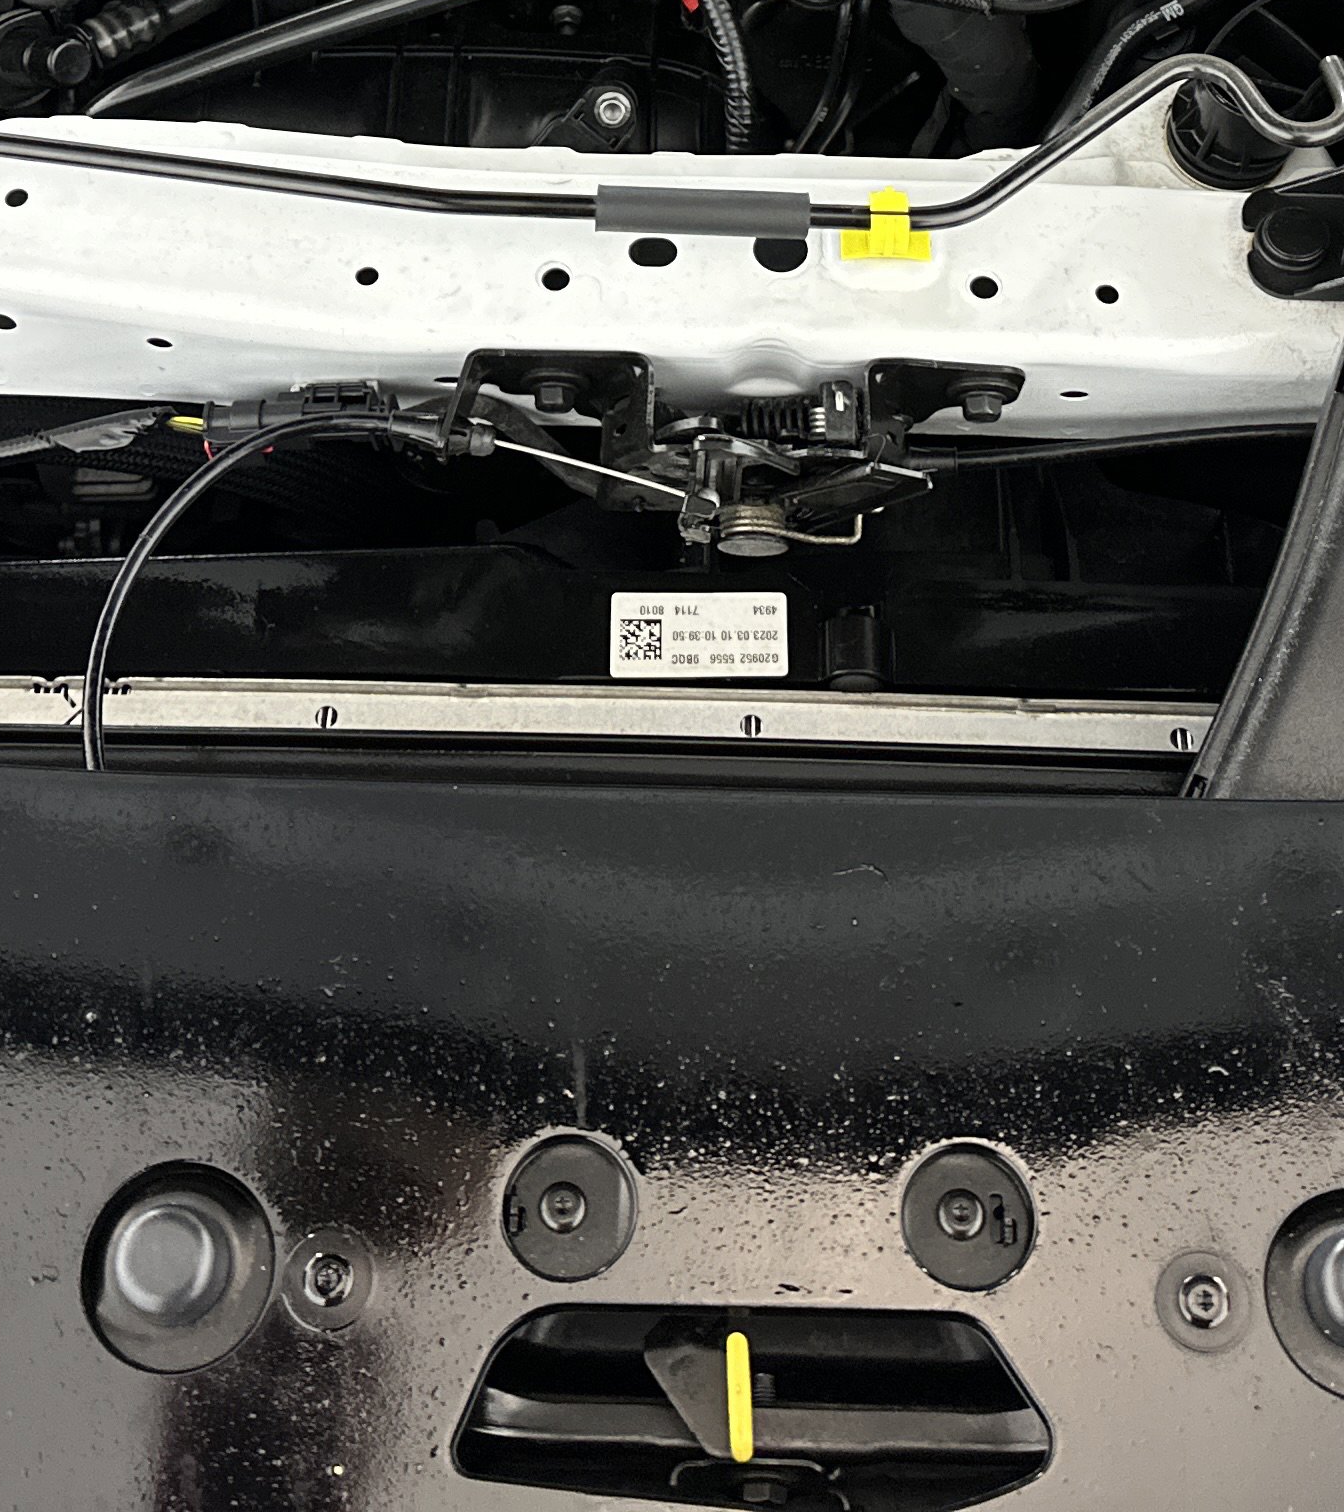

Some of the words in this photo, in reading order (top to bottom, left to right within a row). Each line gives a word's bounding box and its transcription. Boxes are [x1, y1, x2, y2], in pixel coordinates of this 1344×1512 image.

[639, 605, 665, 616] 8010
[674, 605, 699, 616] 7114
[752, 605, 777, 616] 4934
[672, 630, 717, 641] 10:39:50
[721, 629, 779, 641] 2023.03.10
